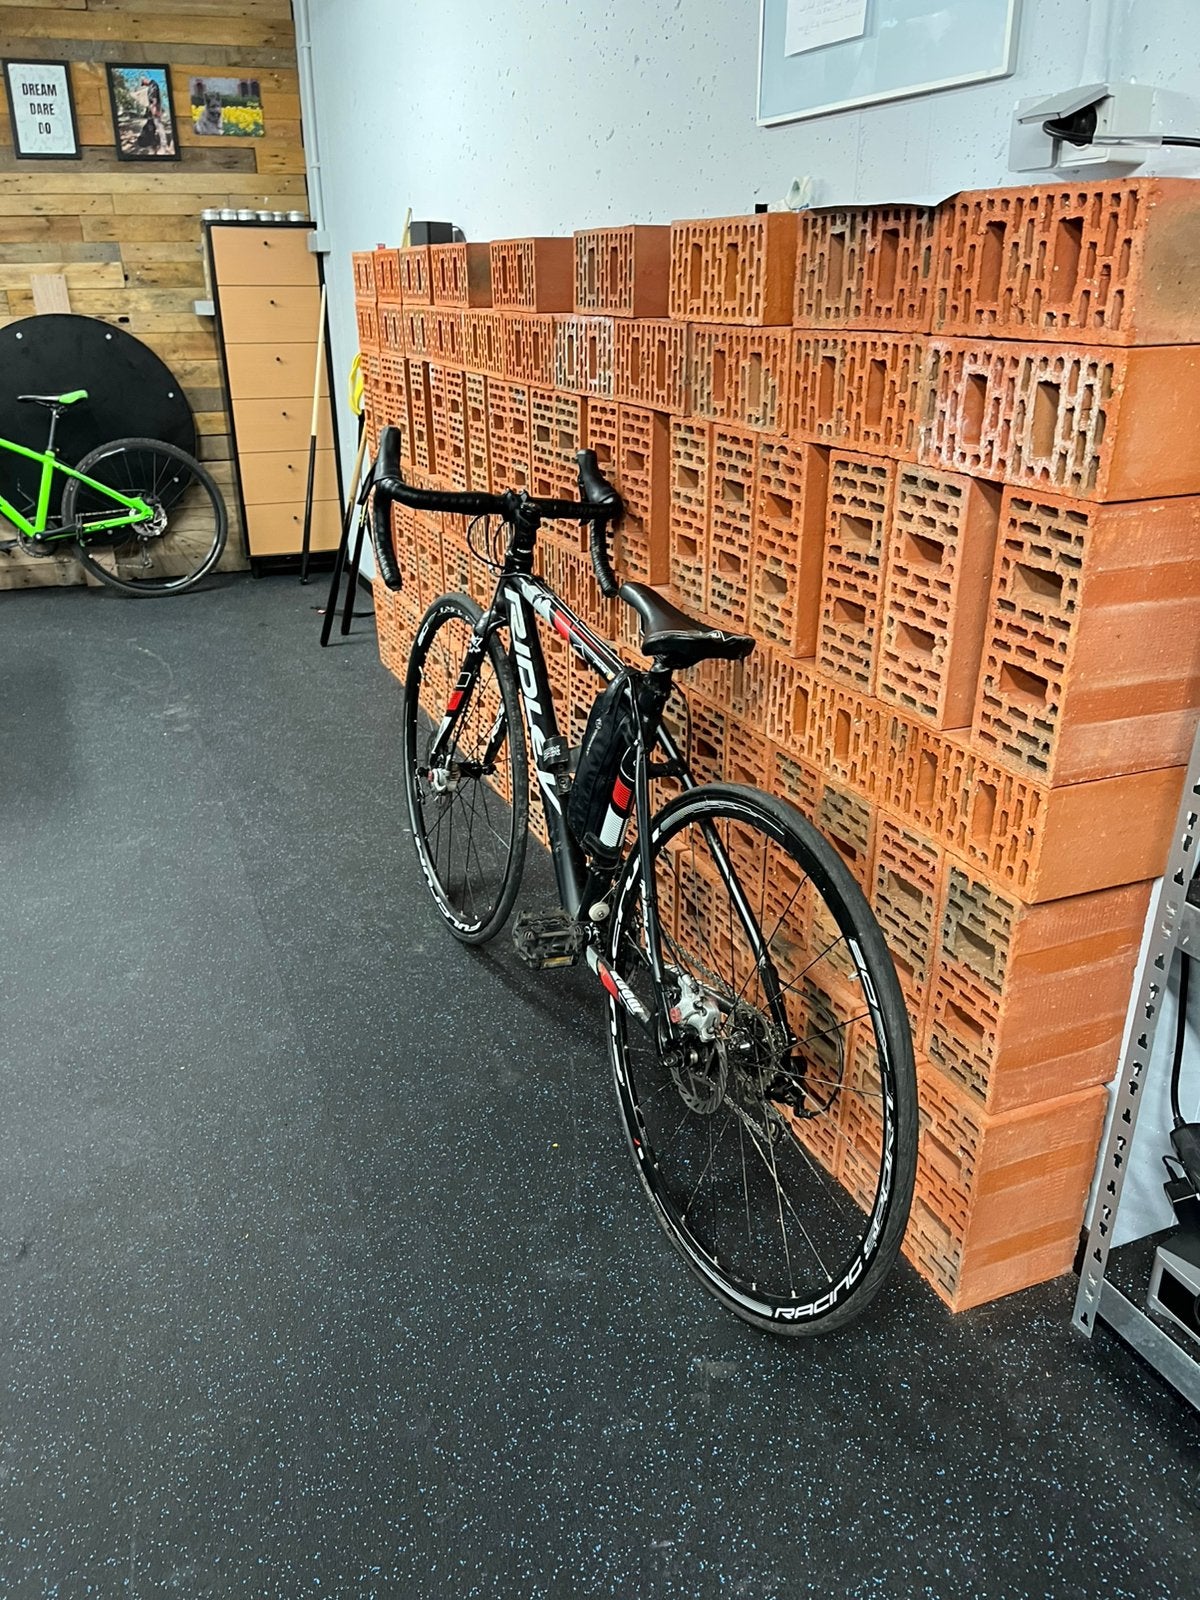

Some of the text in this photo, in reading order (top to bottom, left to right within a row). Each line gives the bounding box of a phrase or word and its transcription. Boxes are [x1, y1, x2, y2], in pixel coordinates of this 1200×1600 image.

[22, 83, 57, 96] DREAM
[29, 102, 55, 115] DARE
[38, 122, 51, 134] DO
[503, 586, 563, 816] RIDLEY
[414, 836, 482, 932] FULCRUM
[773, 1254, 863, 1320] RACING
